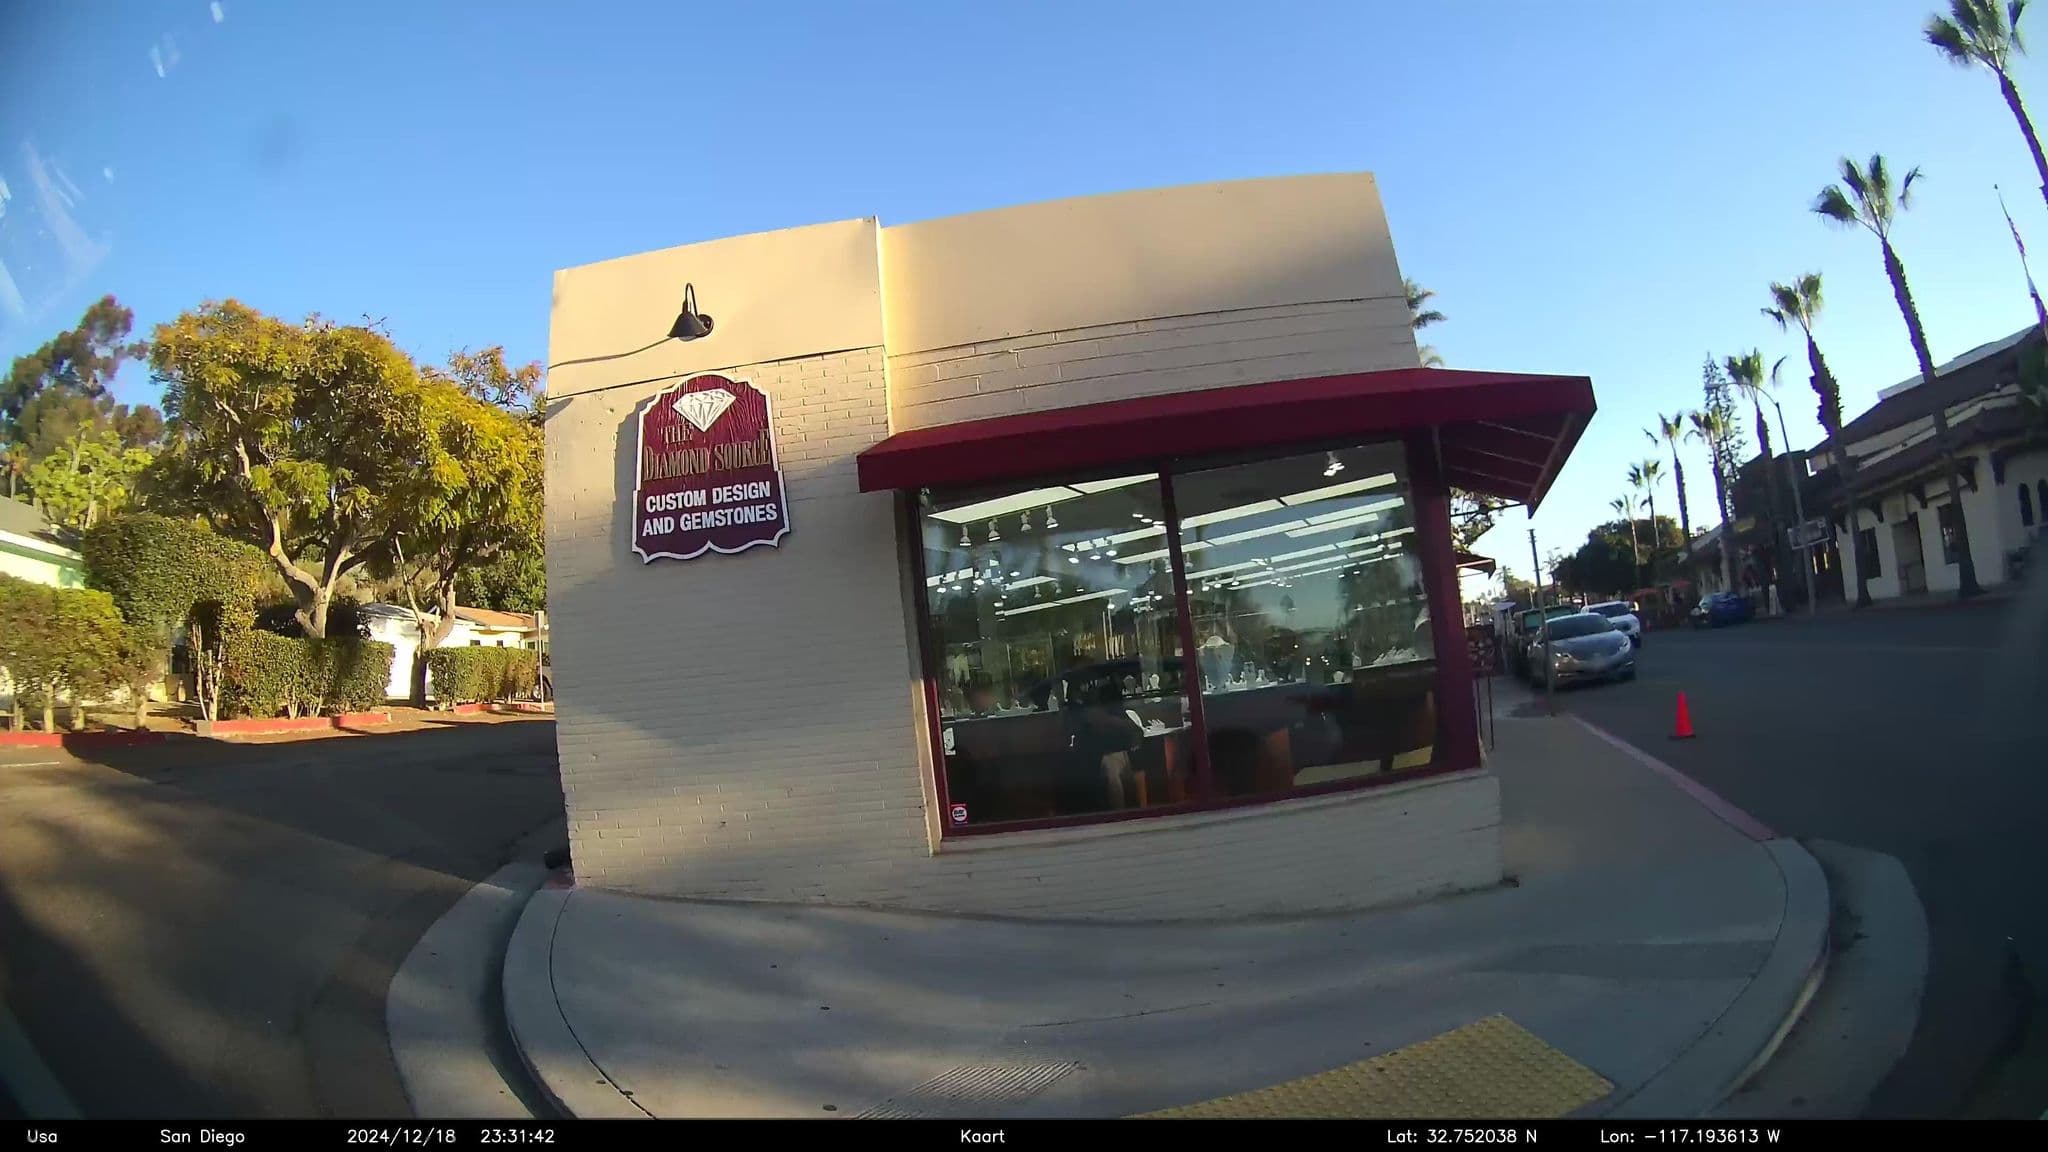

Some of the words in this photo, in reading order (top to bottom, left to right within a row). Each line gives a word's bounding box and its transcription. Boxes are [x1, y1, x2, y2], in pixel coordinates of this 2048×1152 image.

[642, 446, 709, 481] DIAMOND
[714, 429, 771, 471] SOURCE
[645, 489, 706, 513] CUSTOM
[712, 481, 771, 505] DESIGN
[641, 517, 675, 537] AND
[679, 503, 778, 532] GEMSTONES
